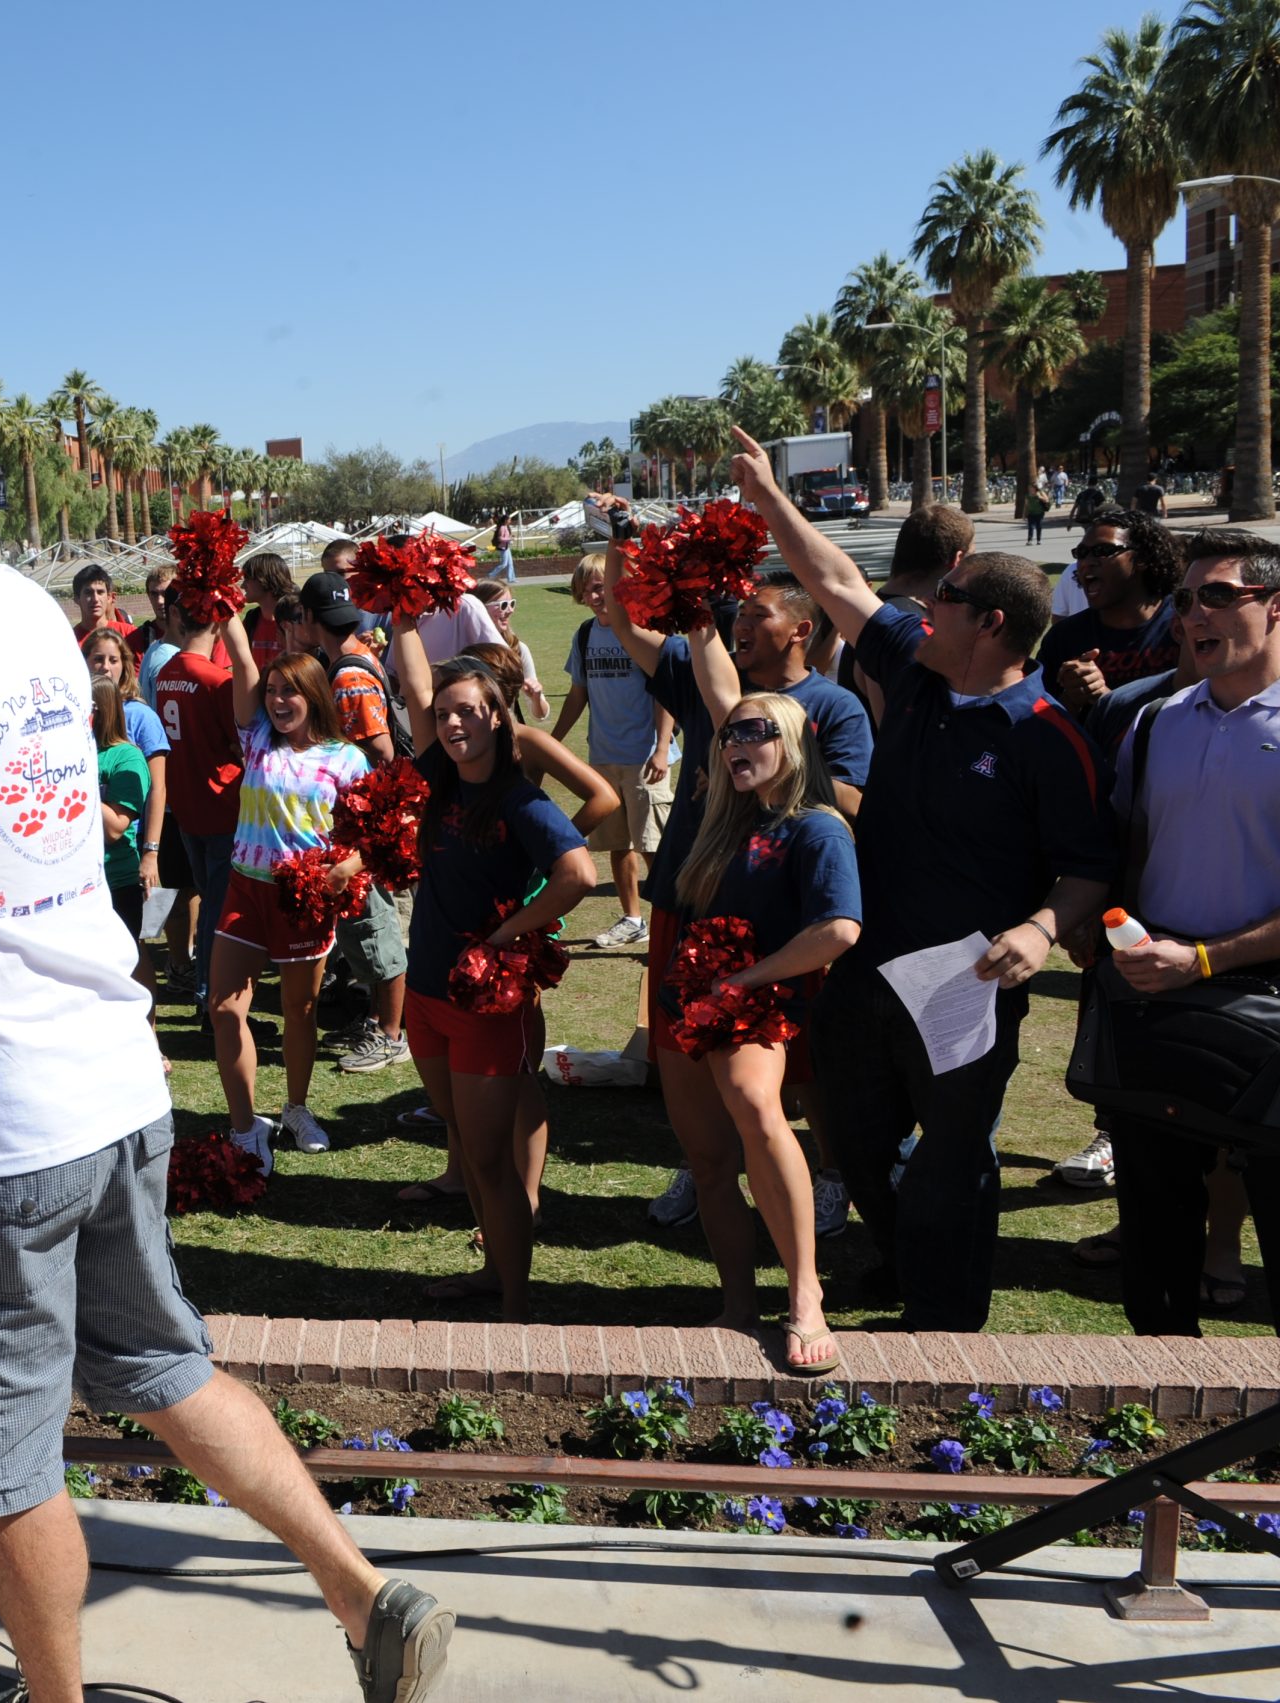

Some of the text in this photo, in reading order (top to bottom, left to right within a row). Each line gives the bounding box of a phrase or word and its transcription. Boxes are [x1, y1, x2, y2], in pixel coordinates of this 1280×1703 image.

[156, 679, 198, 694] UNBURN
[163, 699, 181, 740] 9
[22, 750, 87, 792] Home
